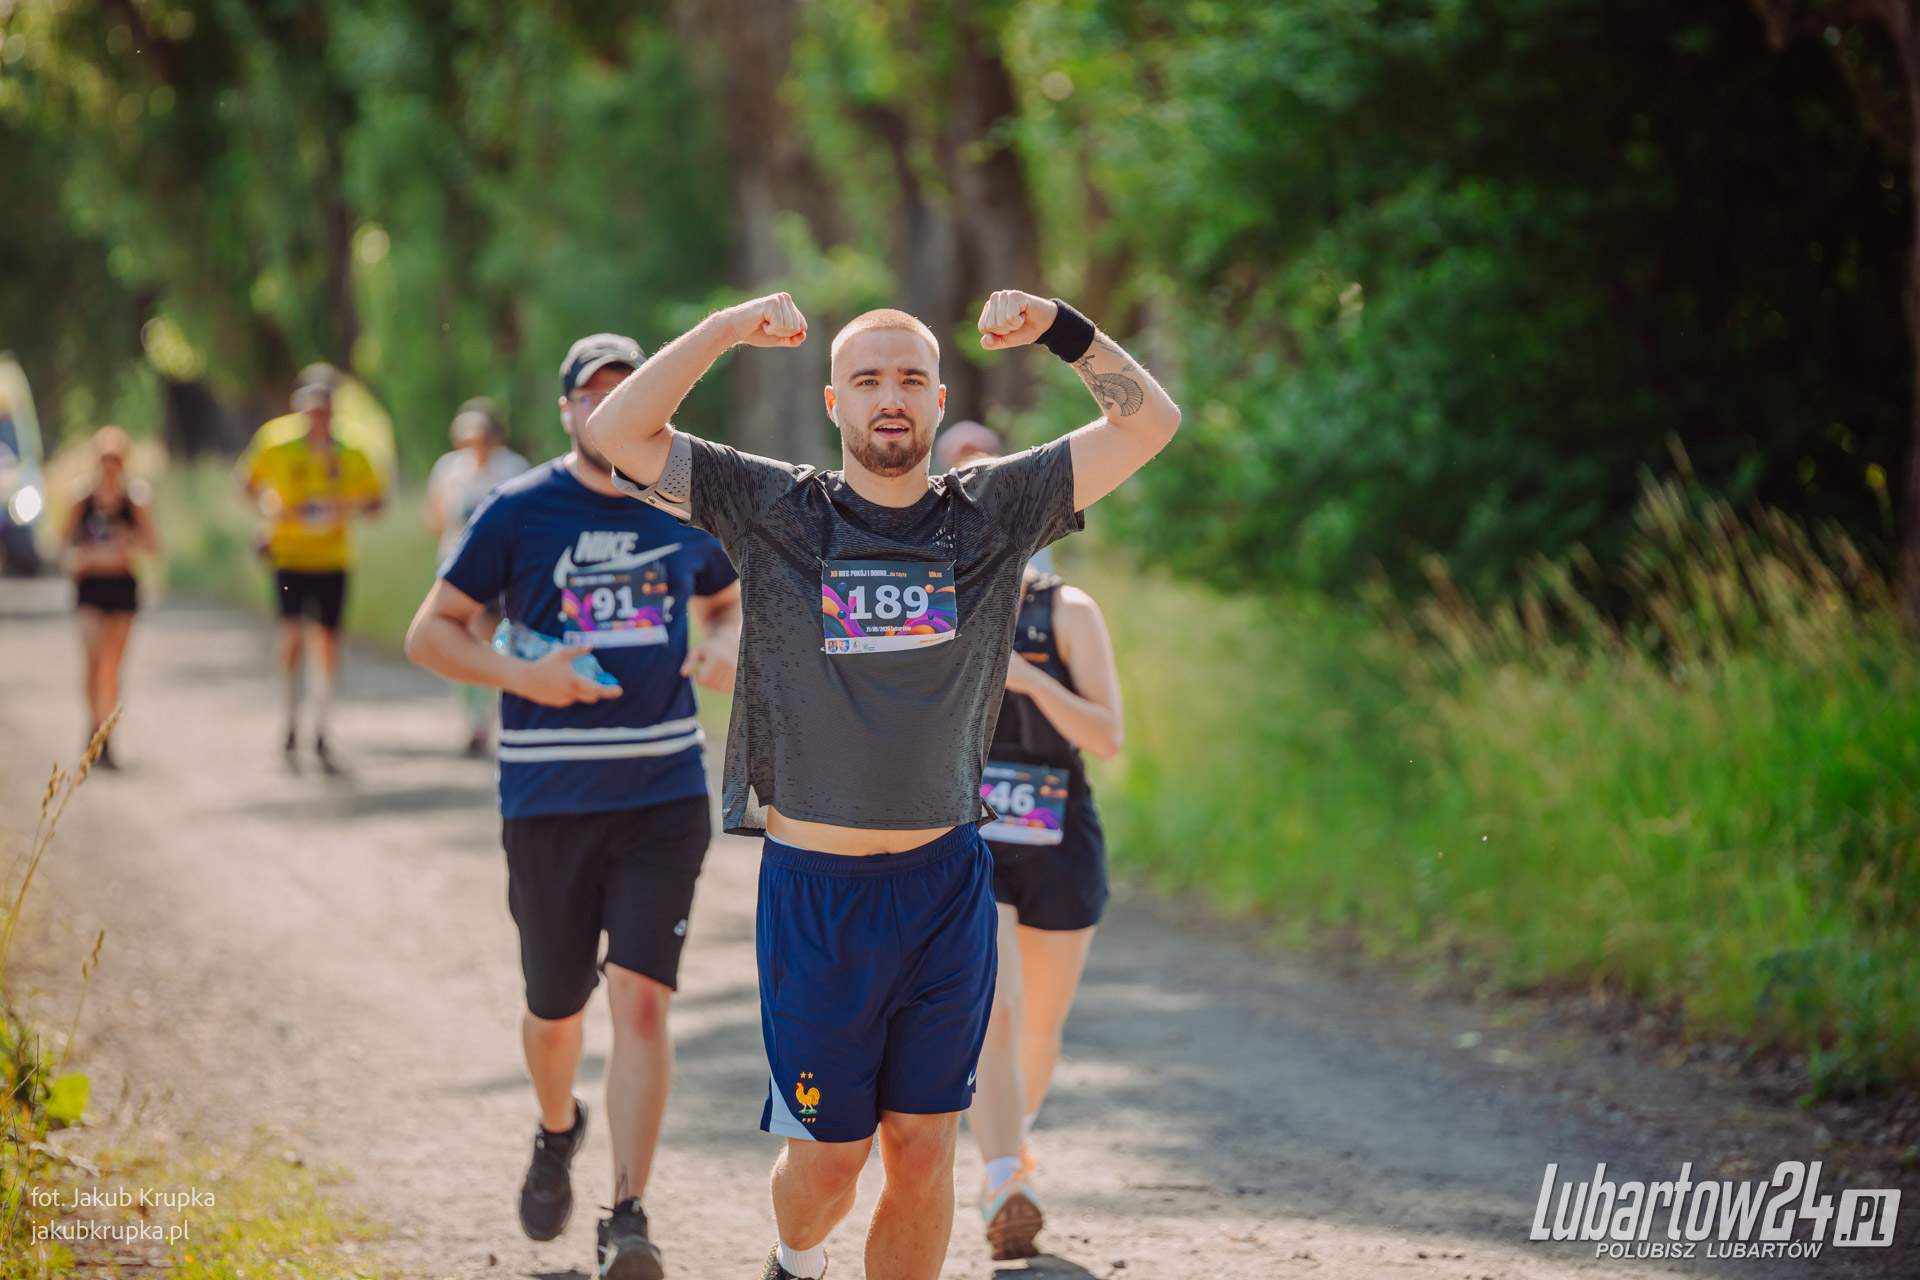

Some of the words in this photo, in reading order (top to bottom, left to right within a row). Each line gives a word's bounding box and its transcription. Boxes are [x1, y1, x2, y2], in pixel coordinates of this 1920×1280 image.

[573, 531, 639, 563] NIKE
[592, 586, 639, 621] 91
[848, 585, 929, 620] 189
[987, 781, 1035, 816] 46
